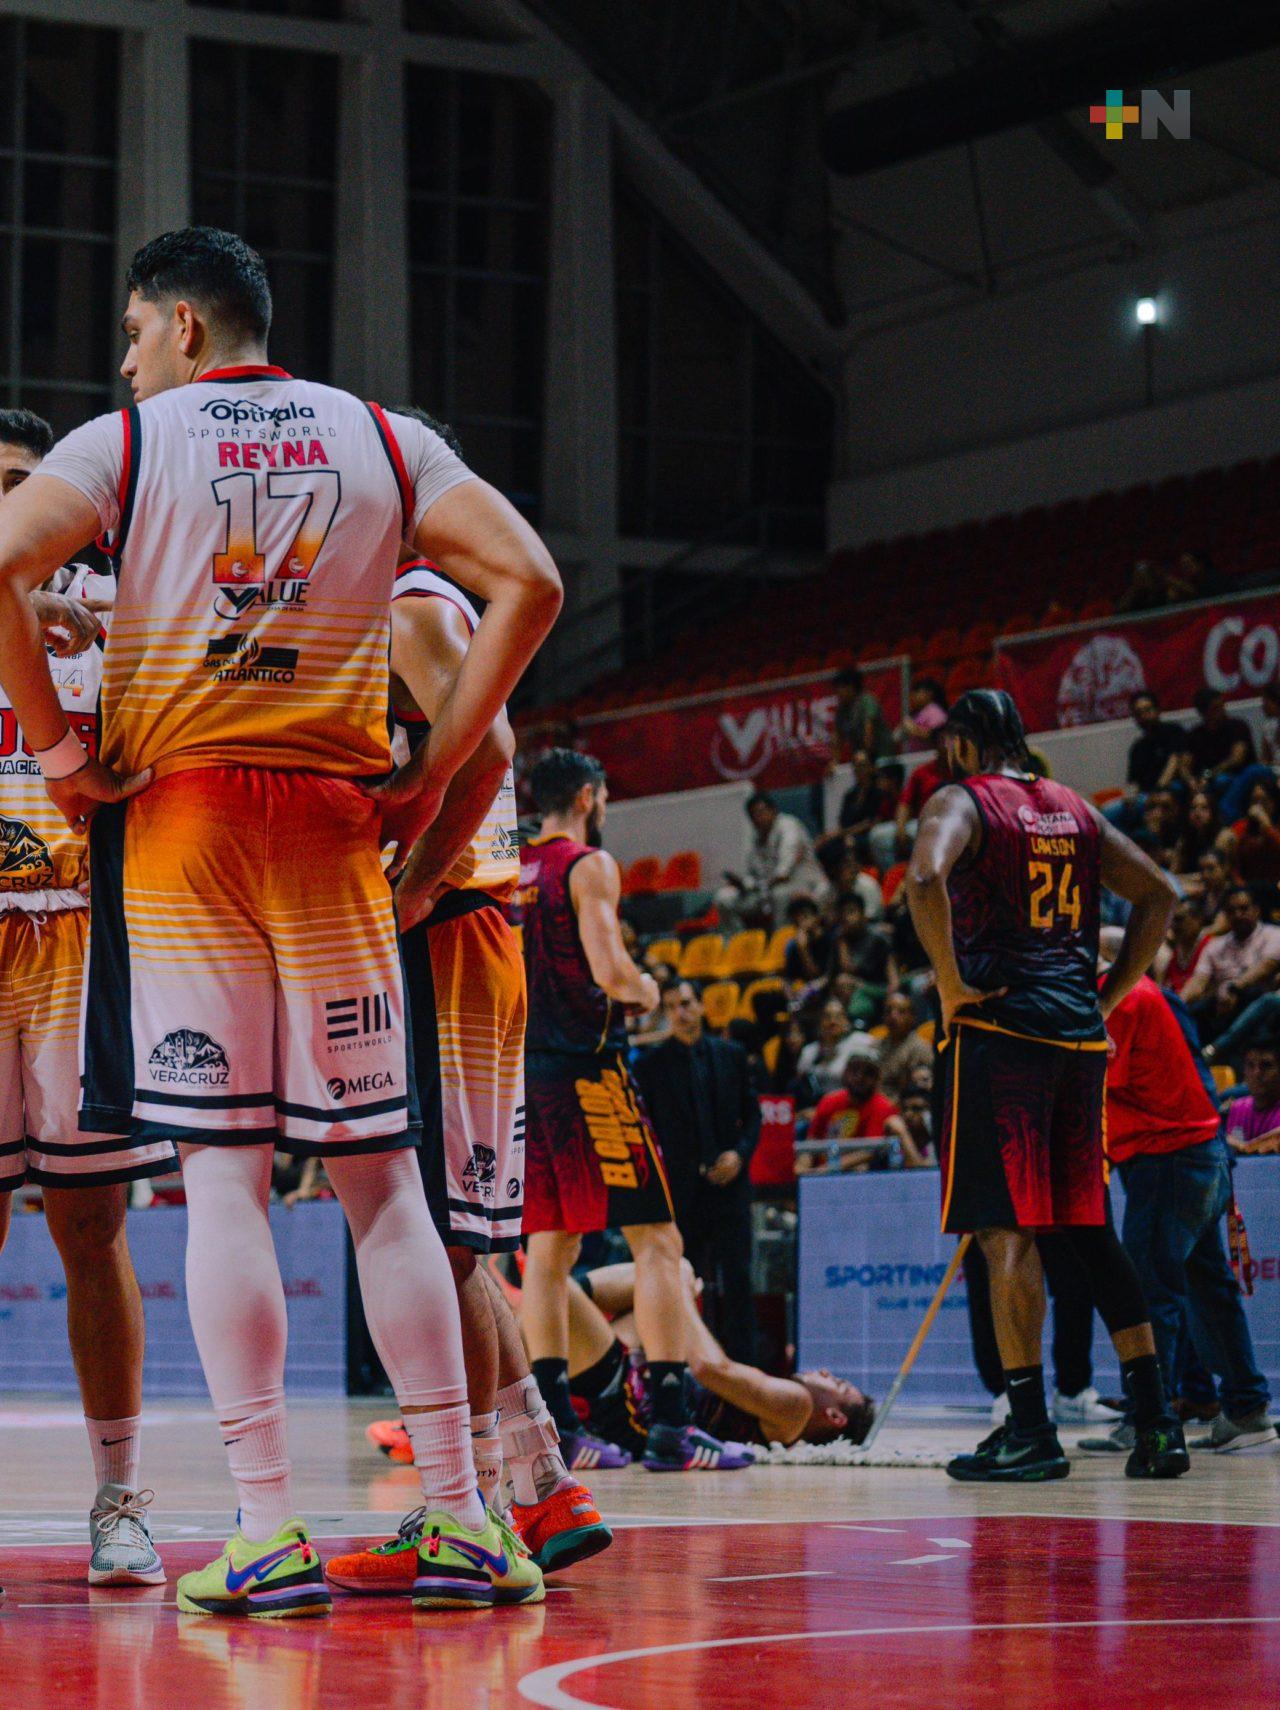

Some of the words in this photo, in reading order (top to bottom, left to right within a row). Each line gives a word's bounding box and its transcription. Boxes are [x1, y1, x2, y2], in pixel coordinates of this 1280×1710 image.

[187, 426, 337, 441] SPORTSWORLD
[217, 439, 329, 470] REYNA
[210, 470, 341, 584] 17
[213, 668, 295, 684] ATLANTICO
[1028, 860, 1082, 930] 24
[326, 1035, 392, 1053] SPORTSWORLD
[149, 1068, 229, 1085] VERACRUZ
